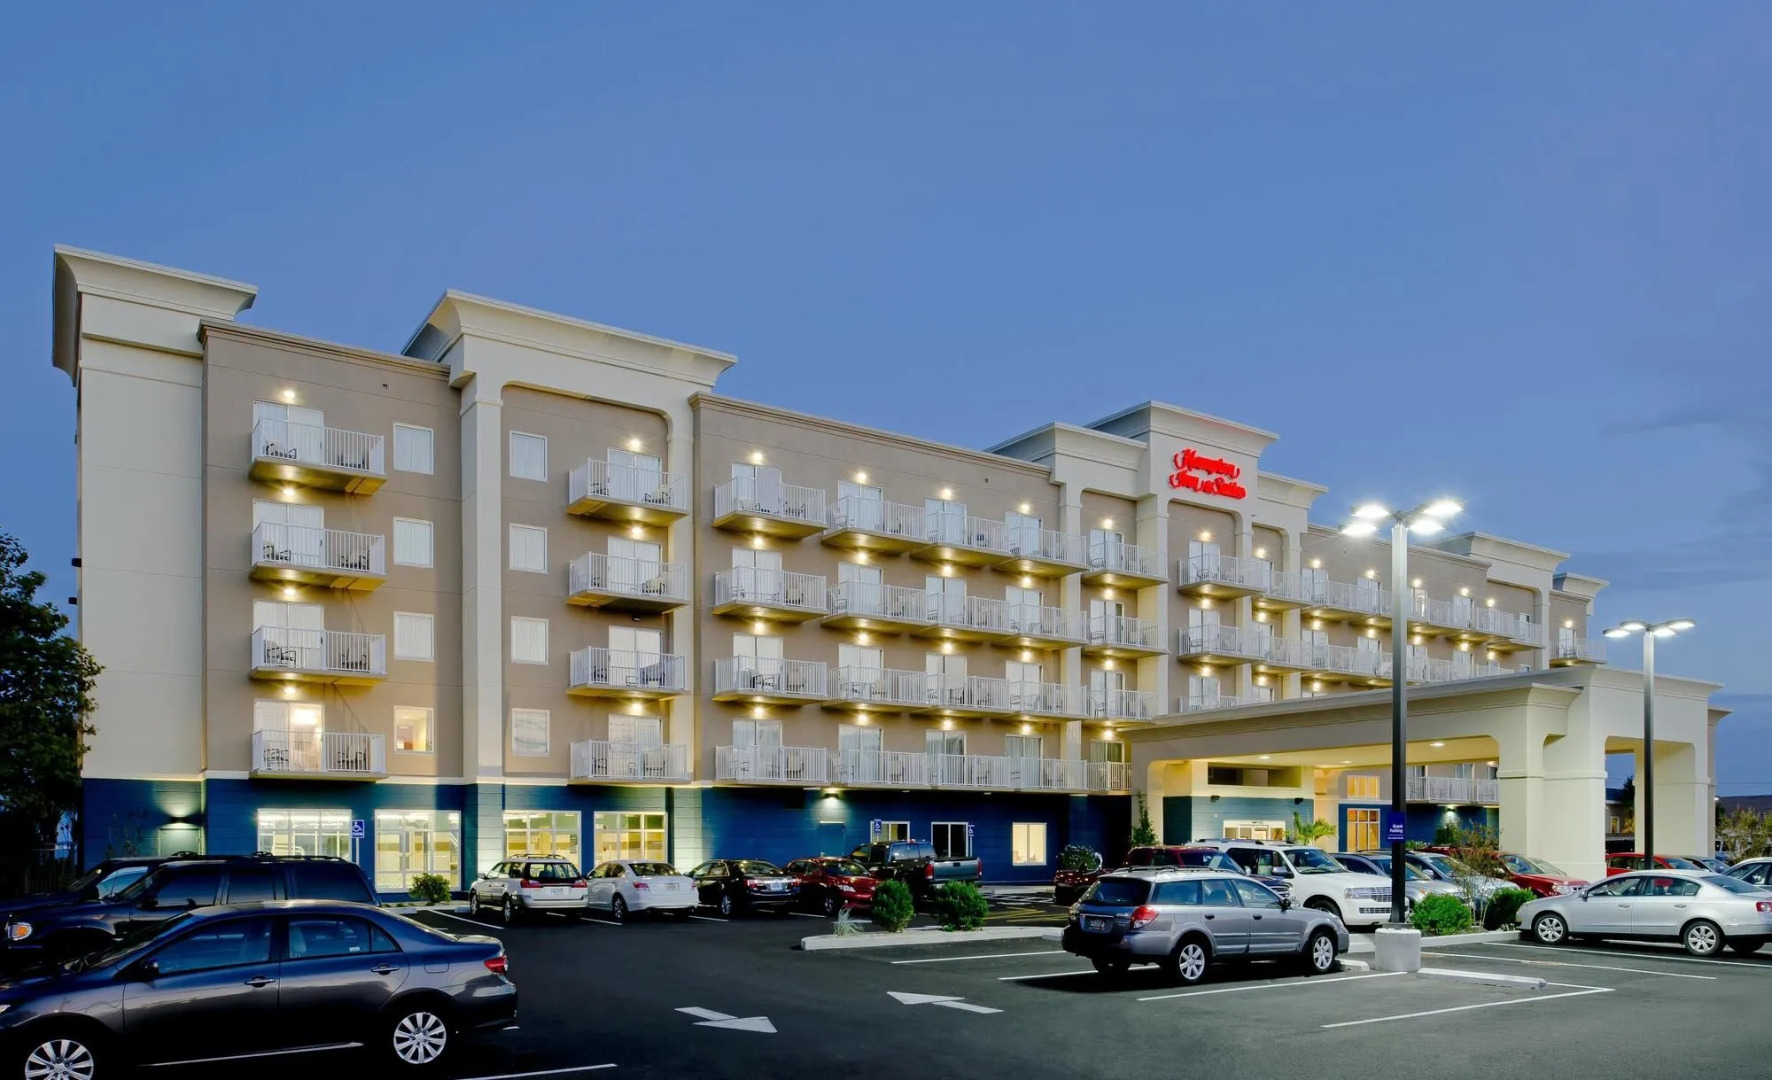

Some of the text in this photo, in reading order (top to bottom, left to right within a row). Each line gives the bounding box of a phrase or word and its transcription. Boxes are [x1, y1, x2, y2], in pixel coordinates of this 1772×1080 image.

[1173, 448, 1241, 480] Hptn
[1169, 469, 1203, 492] In
[1212, 477, 1247, 500] Sit
